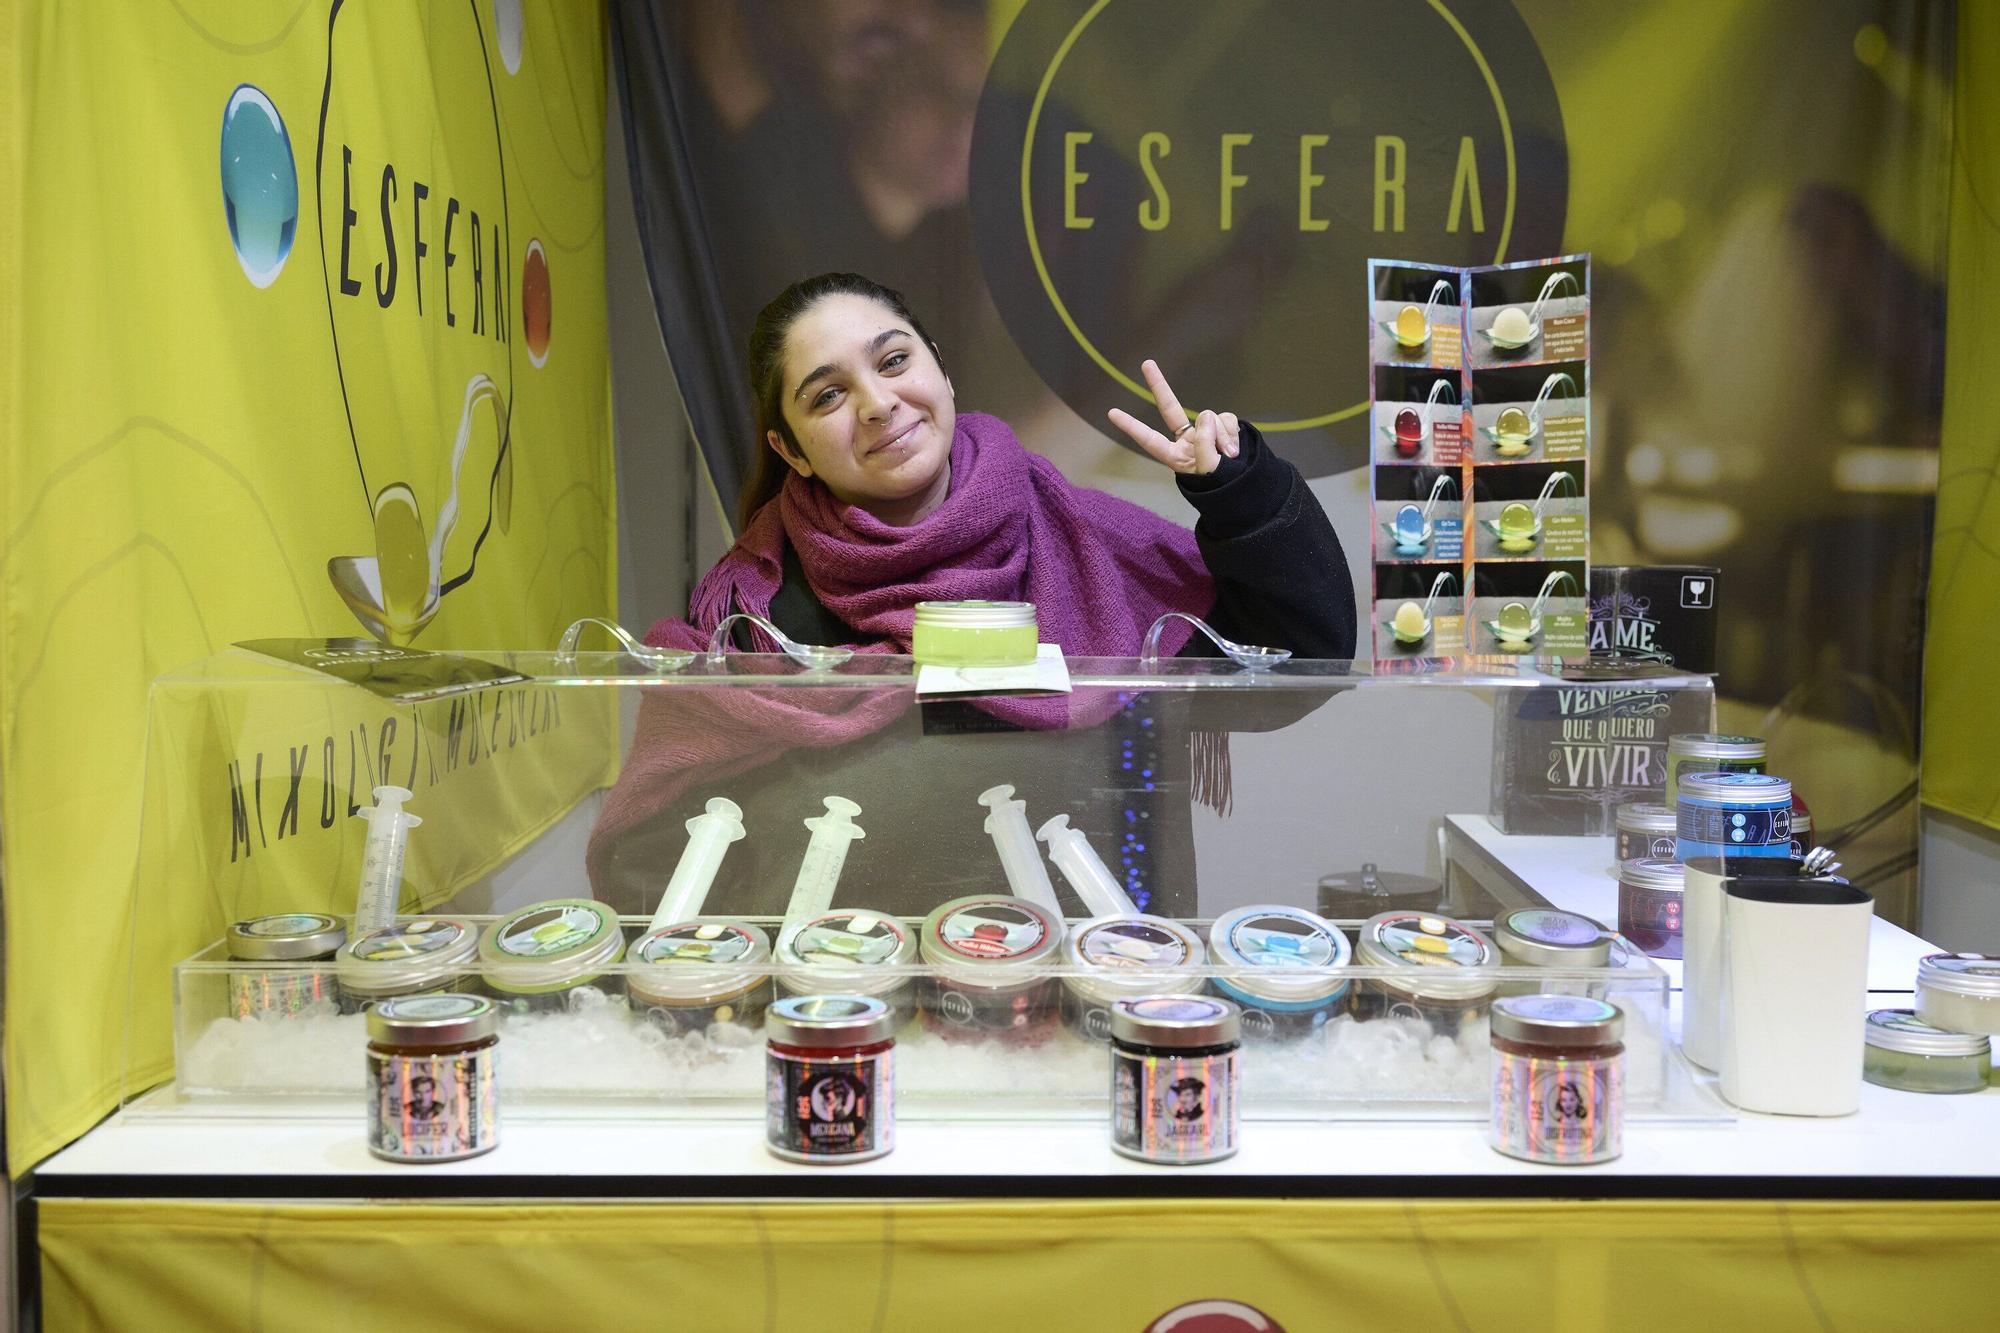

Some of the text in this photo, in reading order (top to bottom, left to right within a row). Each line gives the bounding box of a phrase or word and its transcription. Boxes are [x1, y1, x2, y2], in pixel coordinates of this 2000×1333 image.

[1064, 131, 1485, 232] ESFERA
[340, 143, 506, 344] ESFERA
[1590, 618, 1656, 653] AME
[1562, 717, 1655, 743] QUE QUIERO
[1563, 744, 1651, 788] VIVIR
